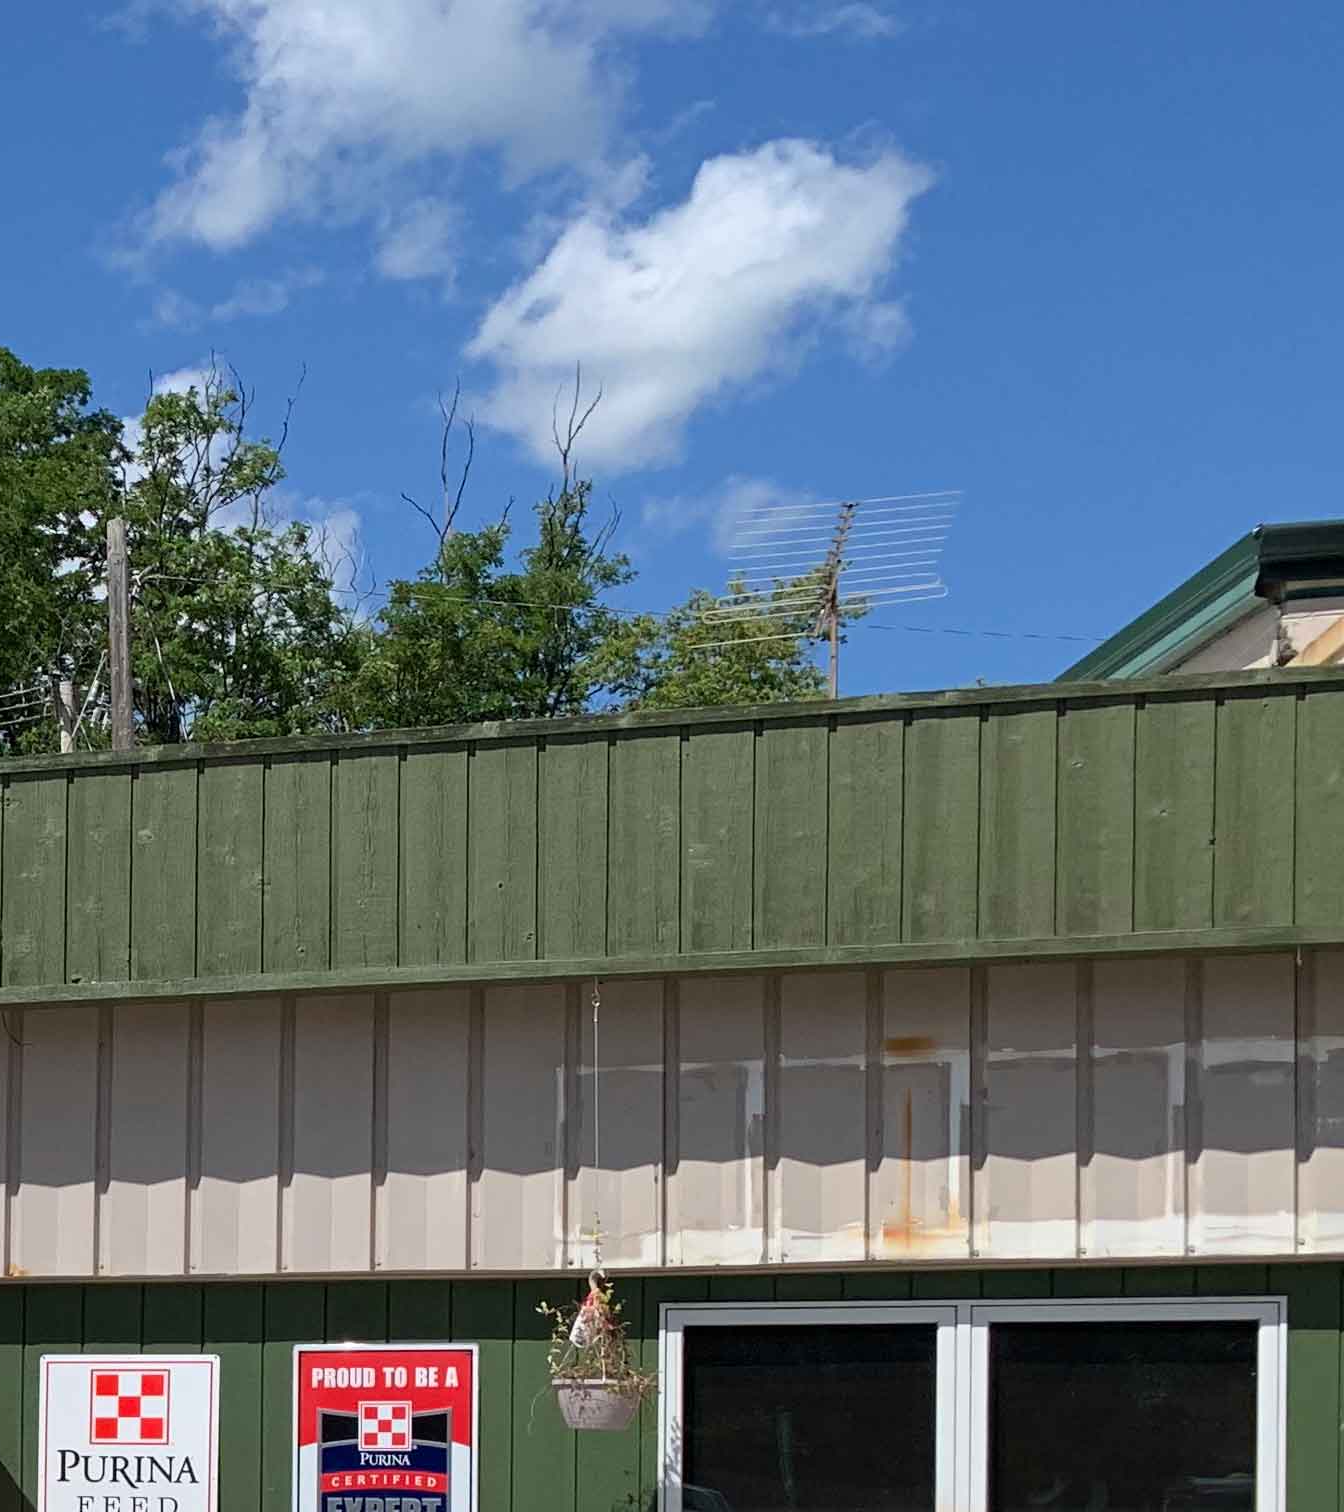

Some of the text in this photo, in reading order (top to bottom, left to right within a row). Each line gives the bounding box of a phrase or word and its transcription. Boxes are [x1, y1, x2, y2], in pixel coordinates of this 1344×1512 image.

[311, 1366, 459, 1389] PROUD TO BE A
[56, 1449, 199, 1488] PURINA
[360, 1452, 410, 1467] PURINA
[331, 1475, 438, 1488] CERTIFIED
